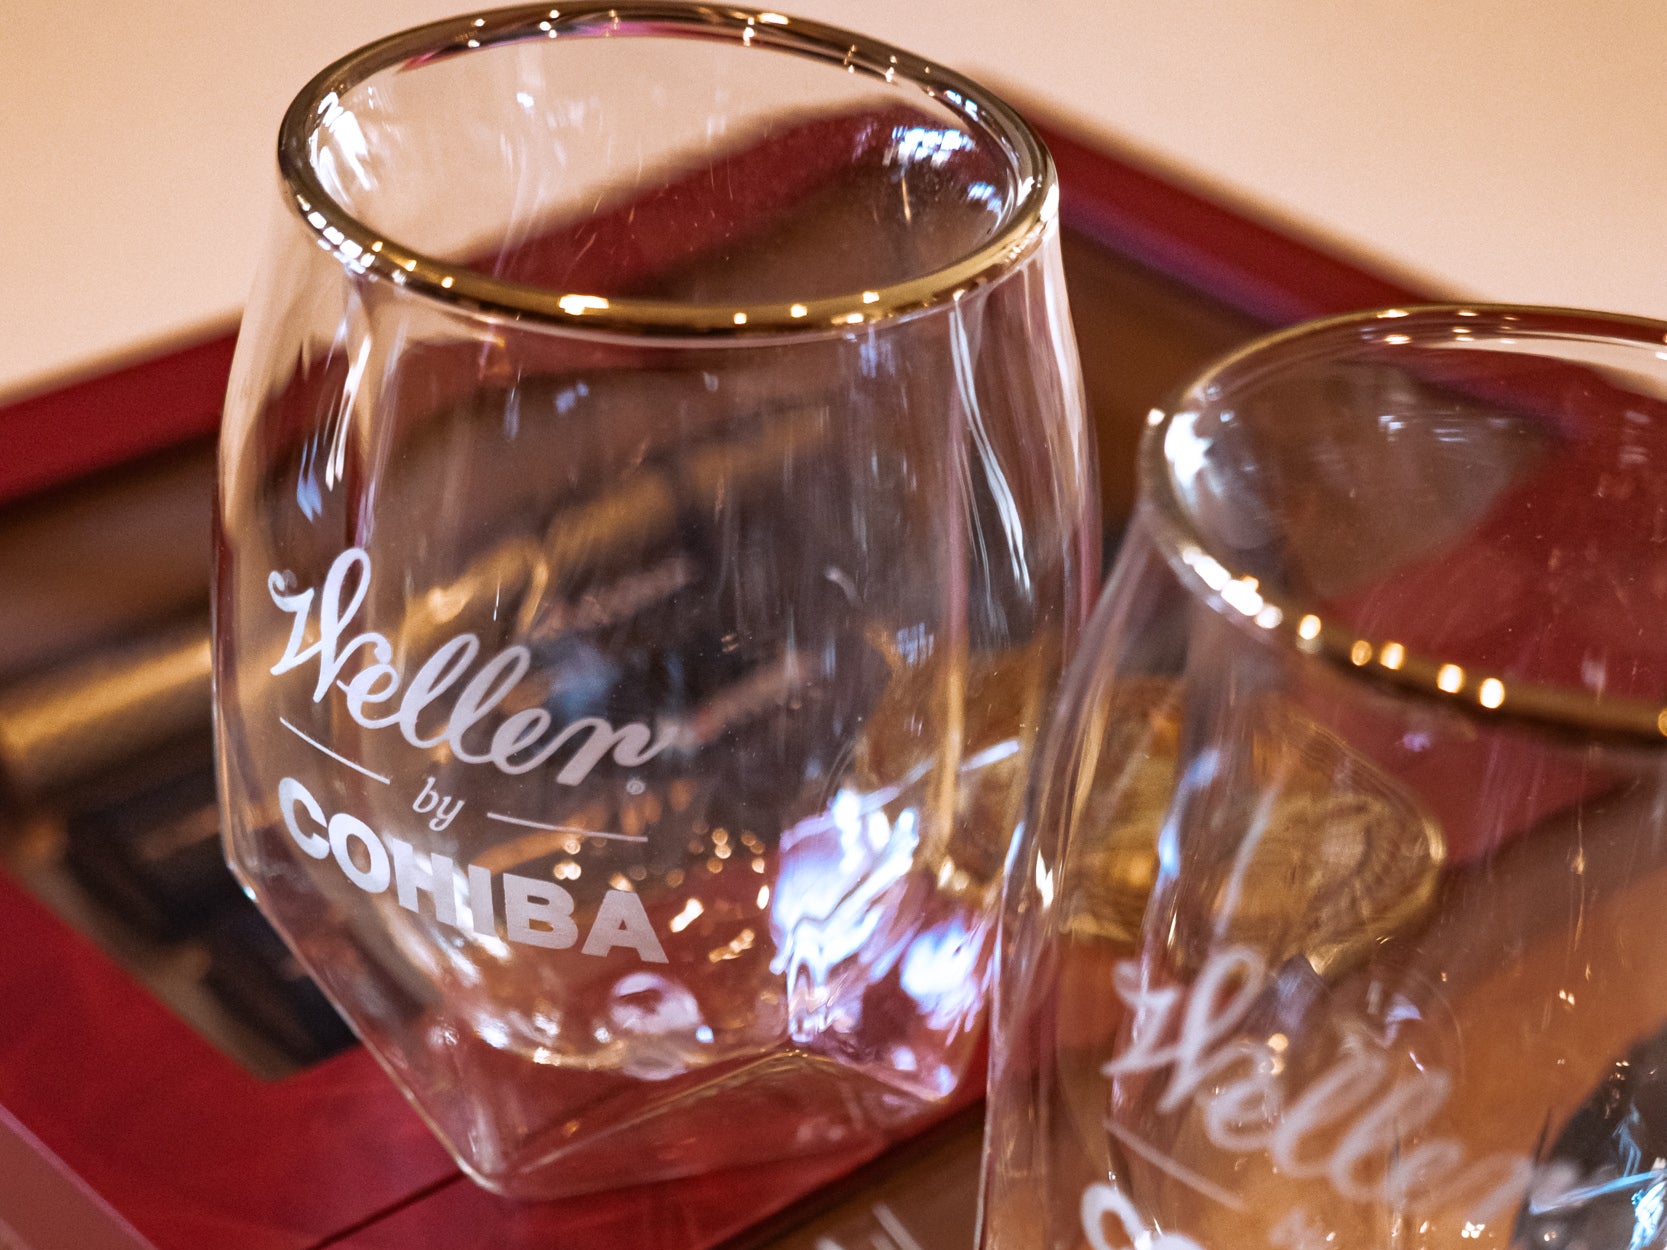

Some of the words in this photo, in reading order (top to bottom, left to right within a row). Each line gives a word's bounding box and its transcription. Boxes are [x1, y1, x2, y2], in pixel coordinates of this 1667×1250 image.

[268, 547, 680, 787] Weller
[278, 777, 670, 965] COHIBA
[412, 776, 465, 832] by
